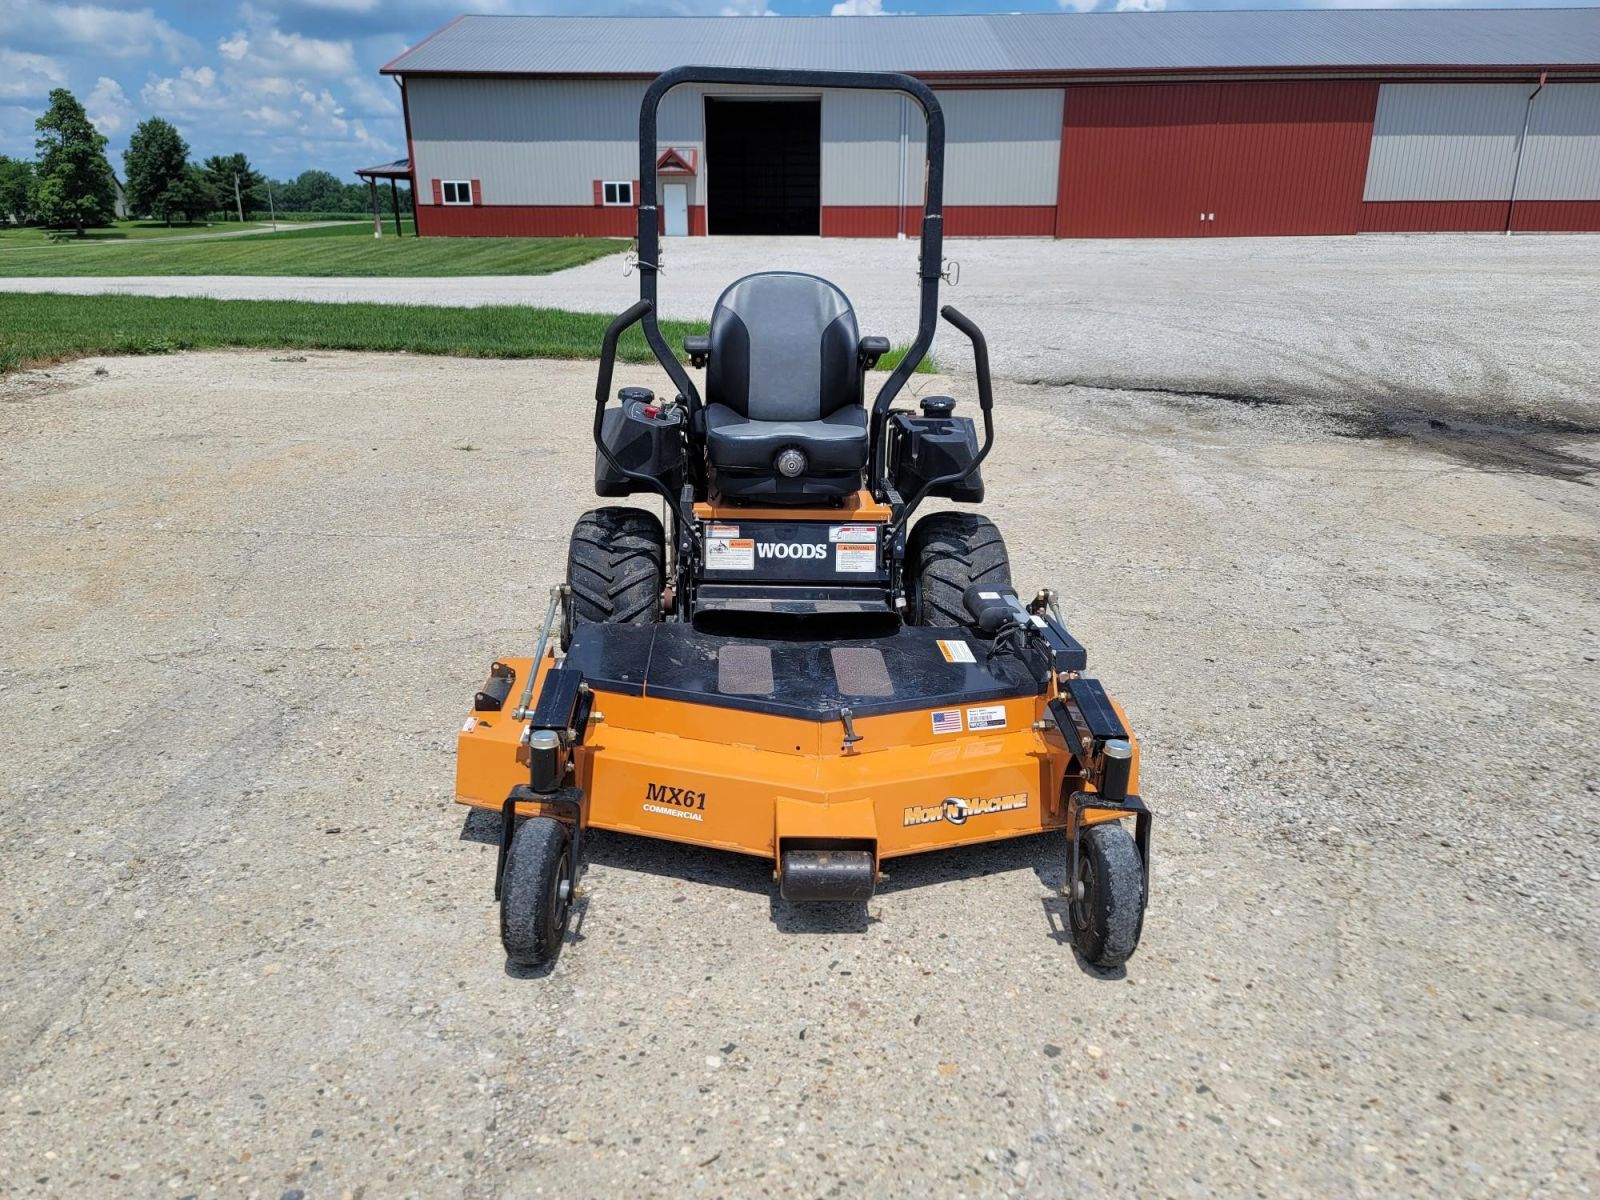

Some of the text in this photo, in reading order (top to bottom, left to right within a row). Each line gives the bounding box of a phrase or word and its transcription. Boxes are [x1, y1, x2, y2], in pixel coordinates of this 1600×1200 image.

[756, 543, 827, 559] WOODS
[646, 783, 706, 810] MX61
[643, 803, 704, 822] COMMERCIAL
